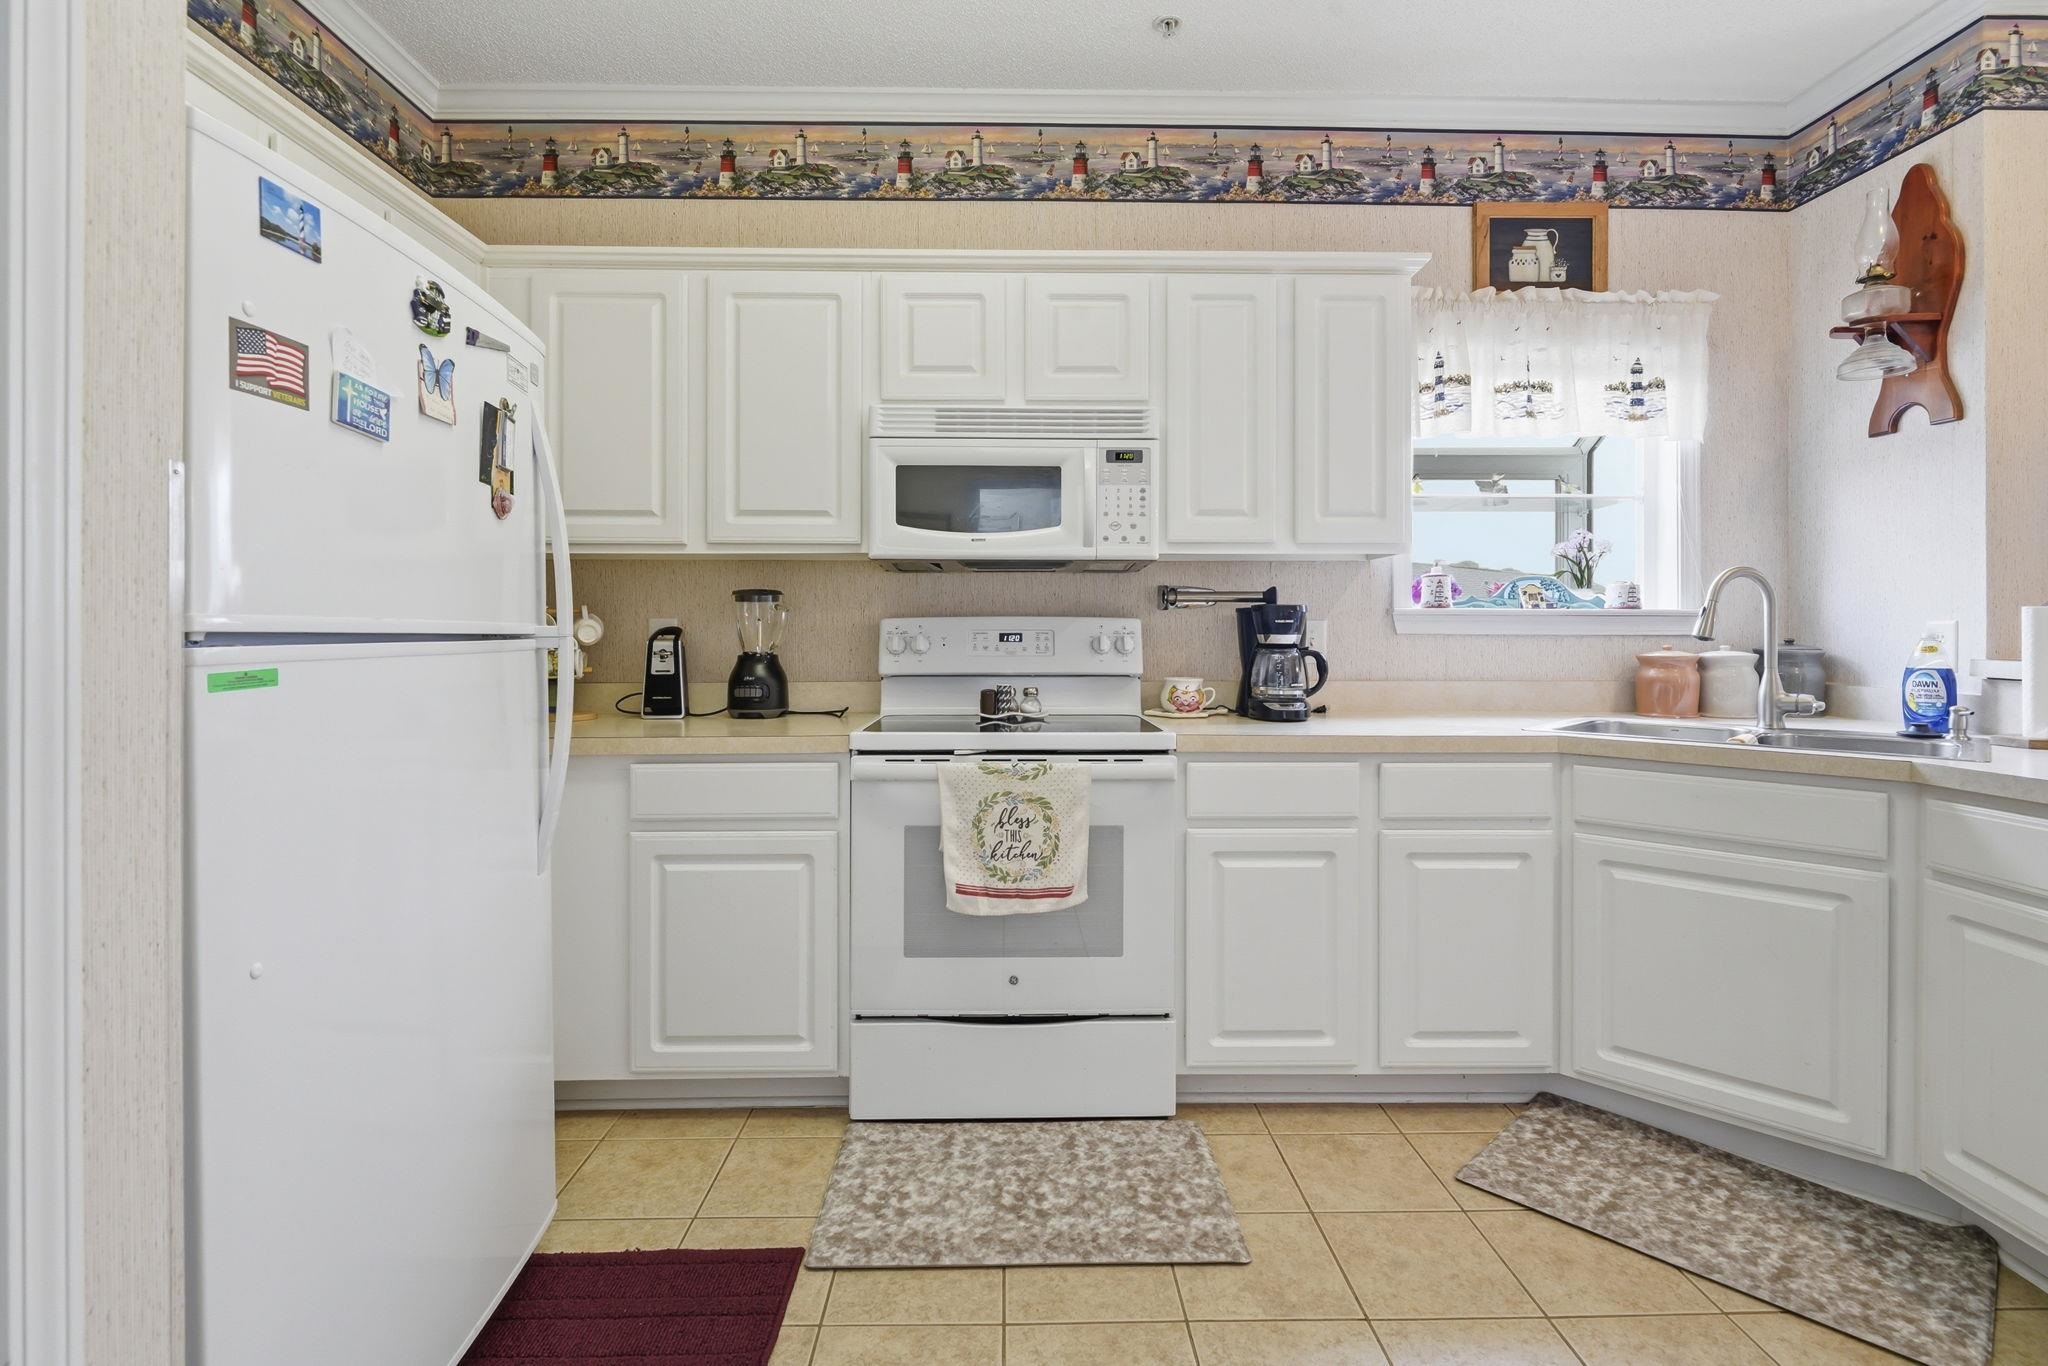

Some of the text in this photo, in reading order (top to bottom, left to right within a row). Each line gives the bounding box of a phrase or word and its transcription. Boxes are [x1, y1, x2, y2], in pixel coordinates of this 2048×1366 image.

[235, 379, 239, 387] I
[239, 381, 272, 396] SUPPORT
[353, 398, 380, 416] HOUSE
[364, 421, 388, 437] LORD
[1912, 680, 1939, 688] DAWN
[993, 805, 1037, 833] bless
[1004, 829, 1022, 843] THIS
[990, 839, 1043, 862] kitchen
